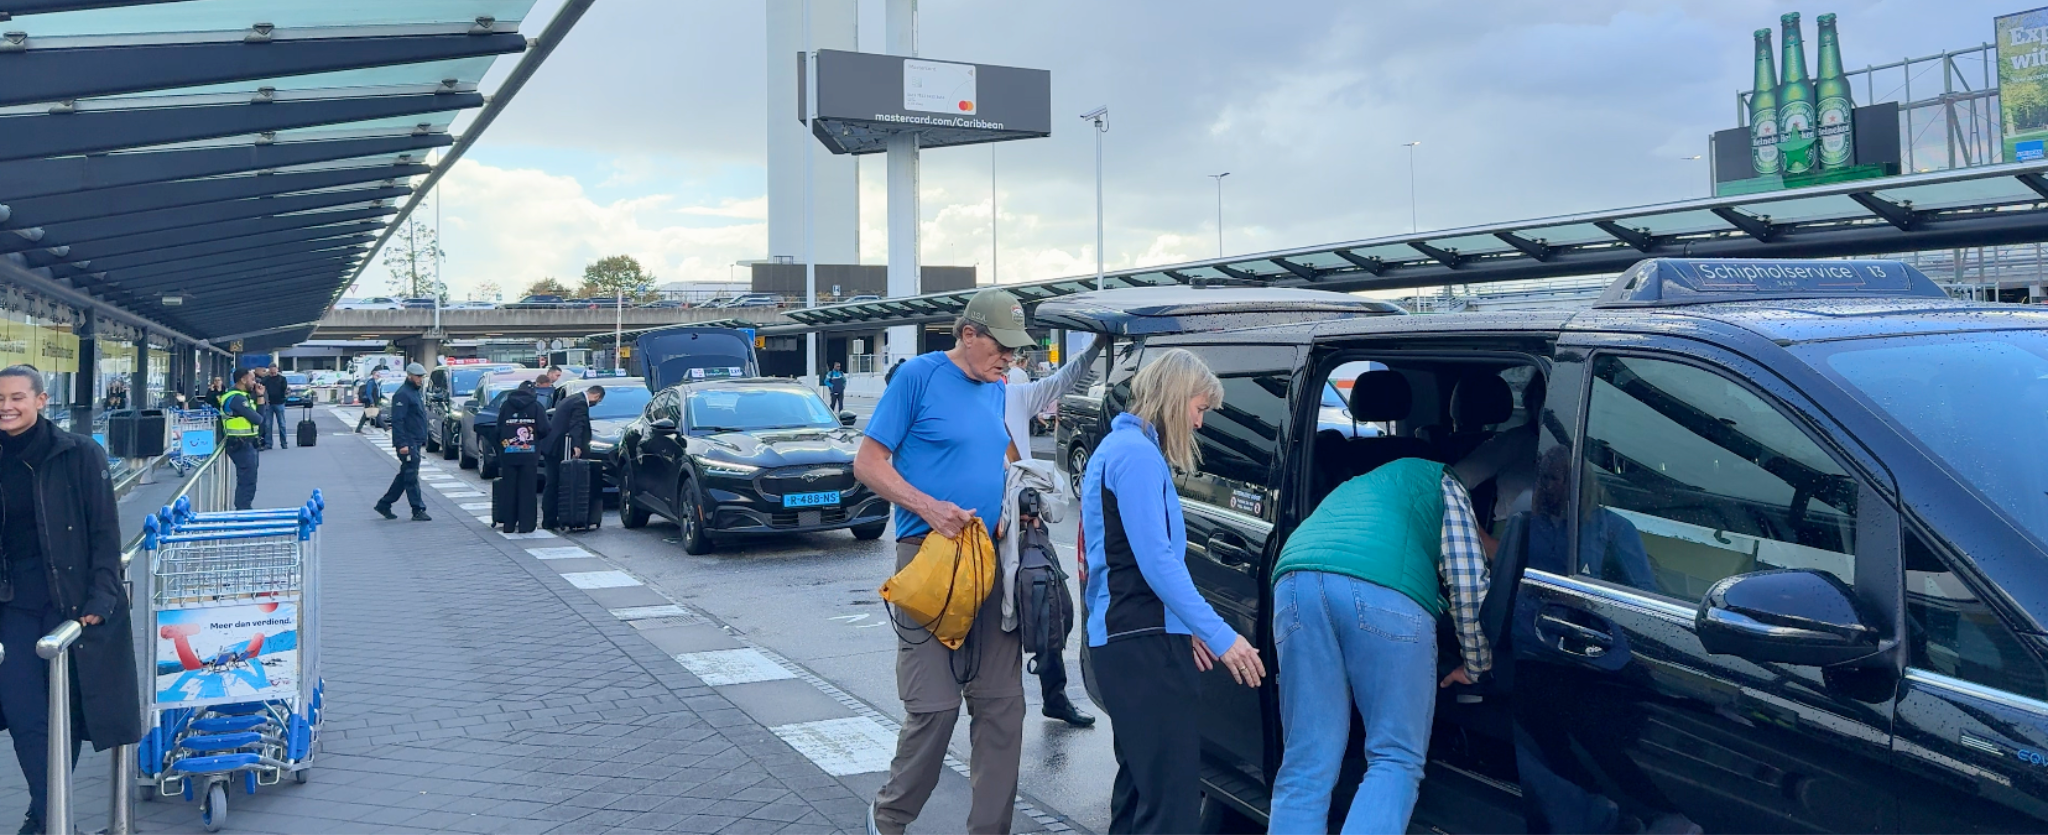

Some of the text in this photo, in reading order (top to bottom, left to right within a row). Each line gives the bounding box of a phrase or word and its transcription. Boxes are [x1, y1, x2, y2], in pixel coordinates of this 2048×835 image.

[875, 113, 1004, 130] mastercard.com/Caribbean
[1699, 264, 1887, 282] Schipholservice 13
[790, 493, 836, 505] R-488-NS
[209, 617, 292, 630] Meer dan verdiend.
